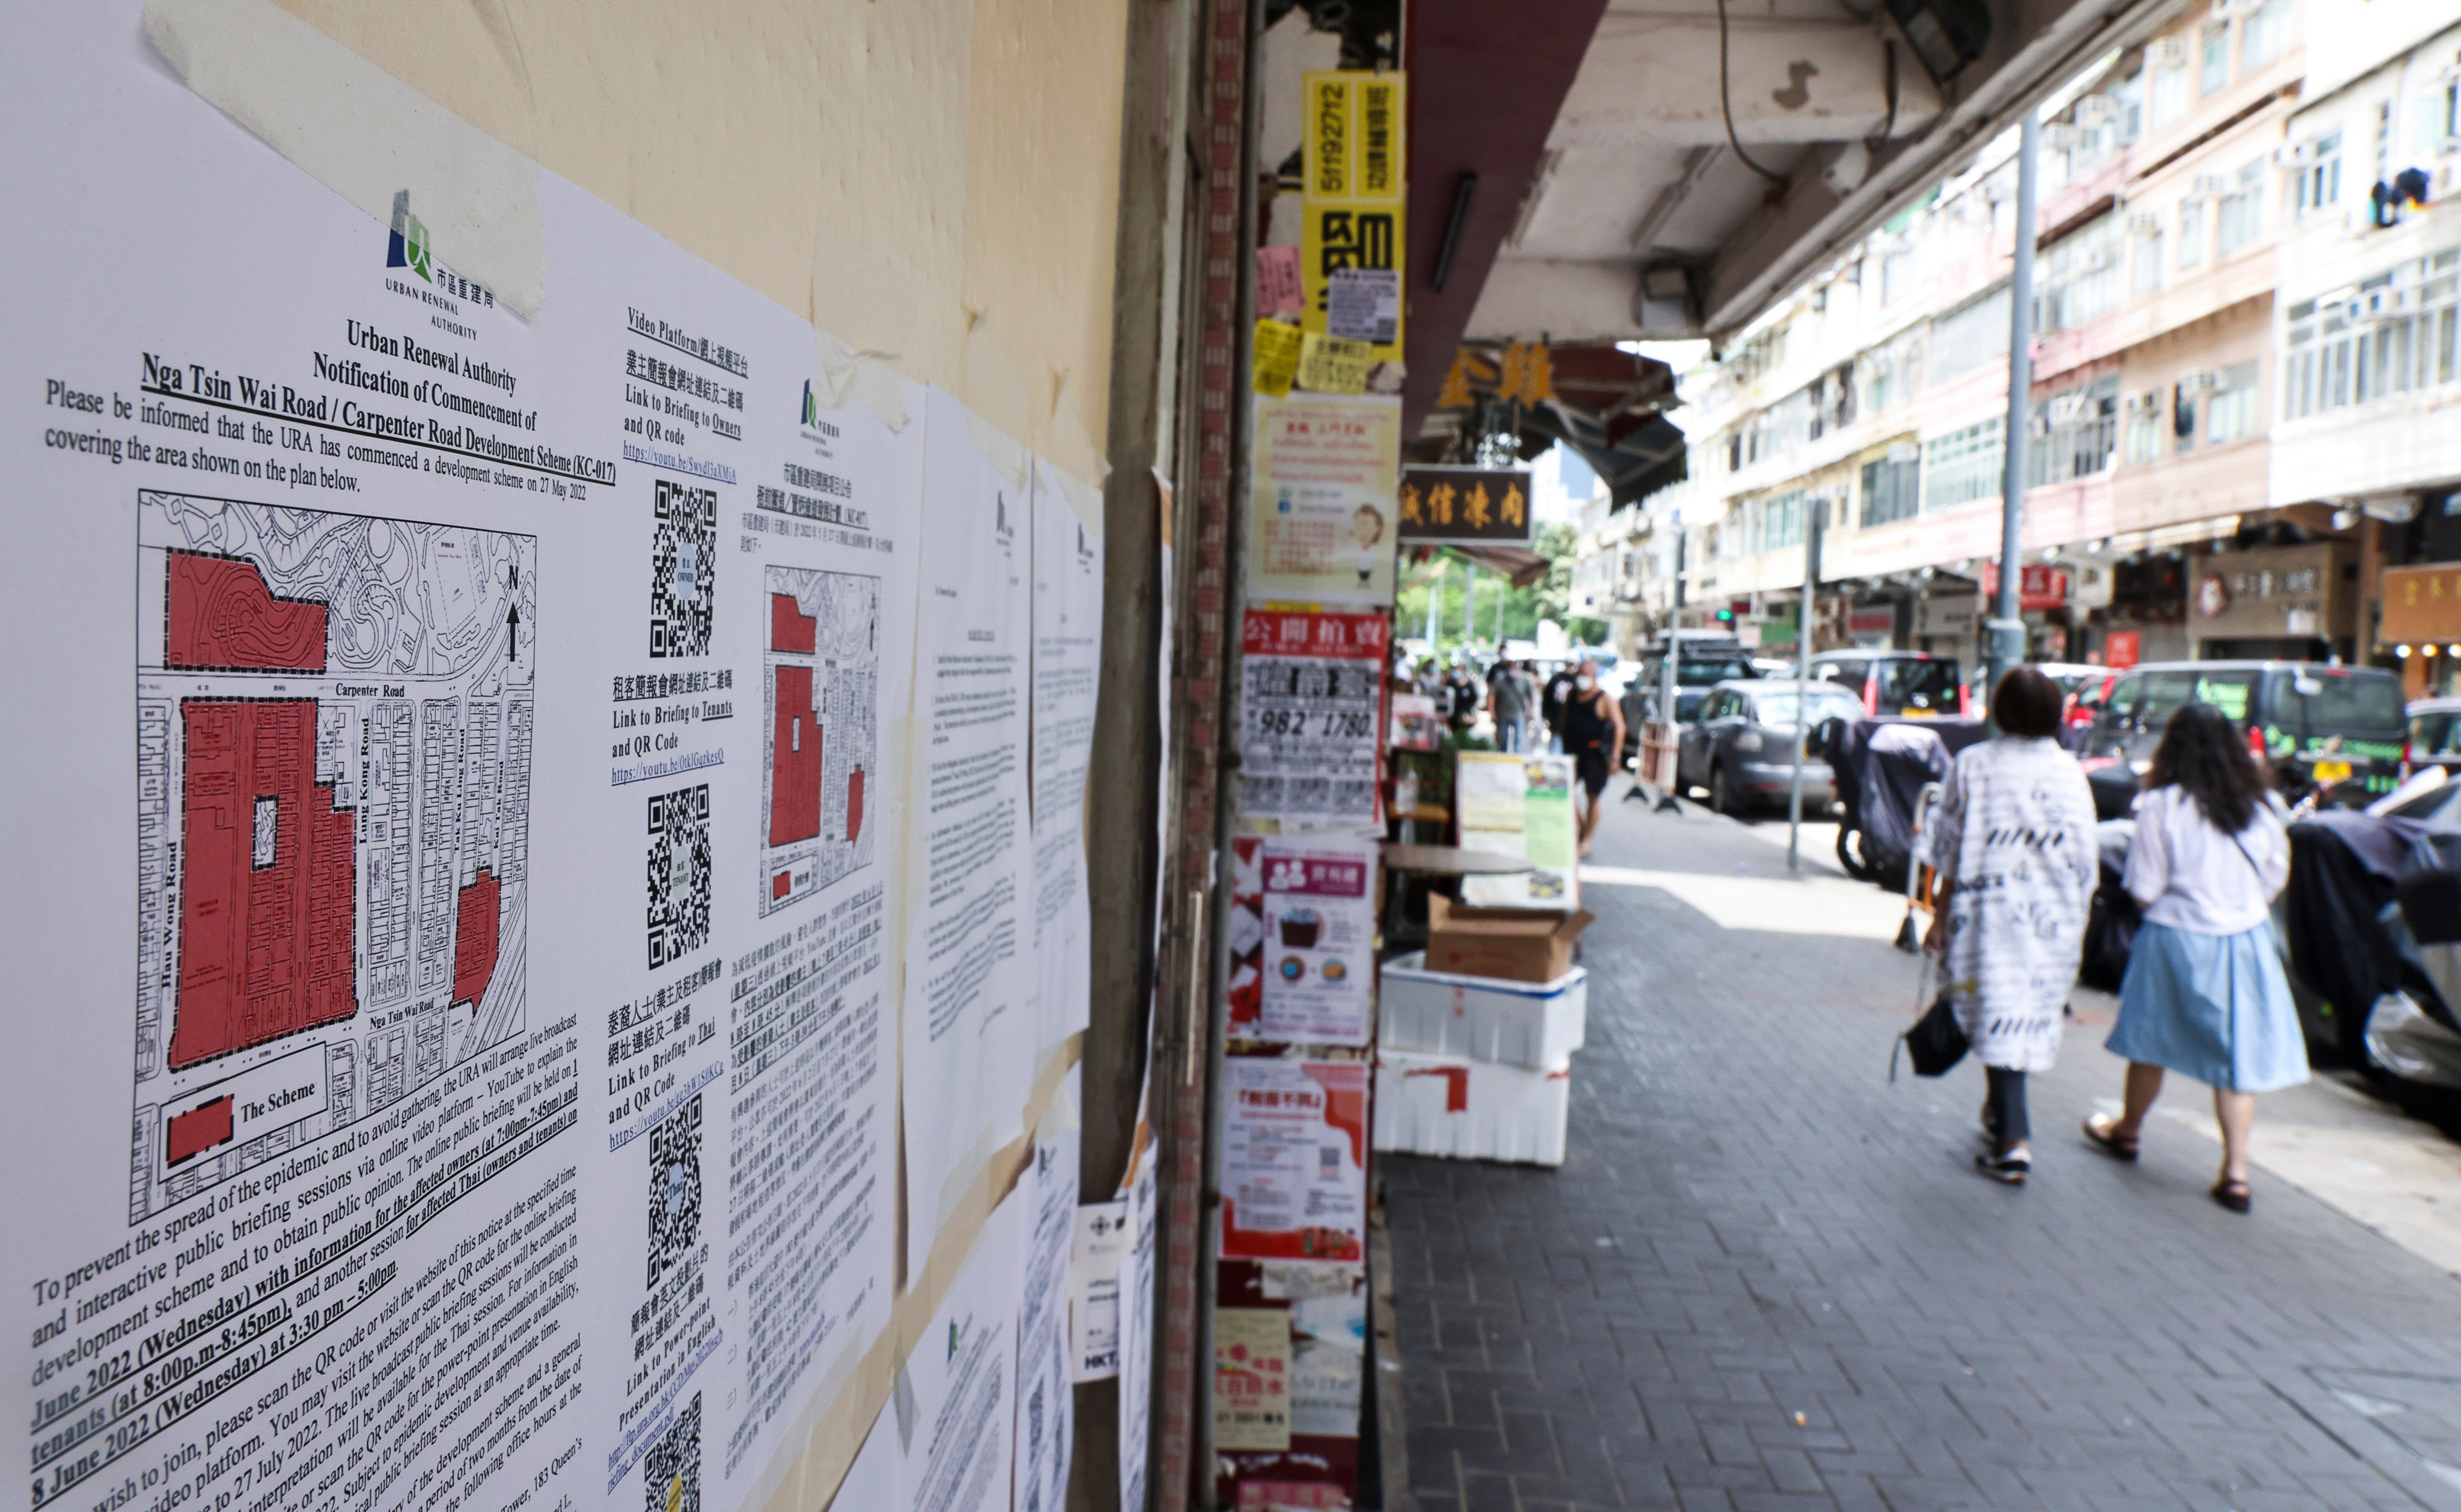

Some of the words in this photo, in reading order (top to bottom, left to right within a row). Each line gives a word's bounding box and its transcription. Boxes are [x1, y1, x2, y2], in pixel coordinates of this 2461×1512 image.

[386, 278, 418, 299] URBAN
[422, 291, 459, 315] RENEWAL
[438, 268, 493, 308] 市區重建局
[432, 315, 477, 340] AUTHORITY
[628, 306, 655, 335] Video
[347, 319, 398, 357] Urban
[403, 335, 459, 375] Renewal
[462, 356, 516, 398] Authority
[314, 351, 409, 399] Notification
[413, 380, 428, 403] of
[432, 383, 522, 428] Commencement
[525, 411, 537, 431] of
[626, 383, 648, 407] Link
[653, 394, 660, 410] to
[665, 396, 699, 428] Briefing
[703, 410, 709, 427] to
[713, 413, 741, 436] Owners
[142, 352, 182, 391] Nga
[190, 364, 231, 401] Tsin
[238, 376, 276, 410] Wai
[282, 386, 328, 425] Road
[342, 401, 424, 440] Carpenter
[427, 418, 463, 453] Road
[465, 427, 536, 469] Development
[536, 445, 573, 476] Scheme
[573, 455, 615, 486] (KC-017)
[625, 417, 642, 434] and
[647, 419, 661, 441] QR
[665, 428, 685, 445] code
[46, 378, 103, 415] Please
[114, 392, 132, 420] be
[141, 397, 209, 434] informed
[217, 414, 245, 441] that
[252, 421, 273, 446] the
[281, 426, 313, 453] URA
[320, 433, 340, 457] has
[347, 445, 418, 470] commenced
[424, 458, 430, 472] a
[435, 455, 490, 484] development
[494, 468, 523, 489] scheme
[528, 478, 537, 492] on
[540, 476, 549, 493] 27
[552, 478, 567, 502] May
[570, 483, 585, 501] 2022
[45, 428, 123, 465] covering
[127, 435, 151, 462] the
[156, 446, 188, 468] area
[192, 447, 239, 475] shown
[244, 461, 261, 478] on
[266, 459, 286, 482] the
[290, 463, 317, 489] plan
[320, 466, 360, 493] below.
[510, 565, 518, 590] N
[678, 572, 693, 582] OWNER
[337, 683, 378, 697] Carpenter
[383, 685, 404, 697] Road
[614, 709, 636, 728] Link
[641, 710, 650, 725] to
[655, 705, 689, 724] Briefing
[692, 704, 698, 718] to
[703, 700, 732, 717] Tenants
[612, 738, 630, 758] and
[635, 736, 650, 757] QR
[656, 732, 678, 751] Code
[360, 761, 370, 800] Kong
[359, 805, 369, 844] Lung
[456, 803, 462, 822] Ku
[166, 842, 177, 887] Road
[673, 873, 689, 886] TENANT
[163, 893, 176, 946] Wong
[162, 951, 172, 988] Hau
[370, 1016, 385, 1029] Nga
[388, 1010, 403, 1024] Tsin
[404, 1004, 418, 1017] Wai
[419, 998, 434, 1013] Road
[609, 1068, 635, 1096] Link
[640, 1064, 649, 1081] to
[653, 1043, 686, 1073] Briefing
[689, 1034, 695, 1047] to
[699, 1017, 715, 1041] Thai
[241, 1102, 264, 1123] The
[269, 1084, 315, 1111] Scheme
[609, 1097, 630, 1124] and
[635, 1088, 650, 1112] QR
[654, 1073, 675, 1097] Code
[32, 1278, 60, 1307] To
[65, 1240, 131, 1300] prevent
[135, 1229, 160, 1255] the
[165, 1195, 215, 1244] spread
[219, 1184, 236, 1213] of
[238, 1179, 260, 1204] the
[264, 1147, 329, 1194] epidemic
[332, 1131, 355, 1160] and
[358, 1130, 369, 1148] to
[372, 1108, 399, 1141] avoid
[401, 1088, 442, 1129] gathering,
[444, 1078, 457, 1097] the
[459, 1062, 480, 1088] URA
[481, 1051, 498, 1075] will
[500, 1041, 528, 1066] arrange
[530, 1032, 543, 1050] live
[544, 1013, 576, 1041] broadcast
[669, 1175, 682, 1200] Thai
[31, 1385, 82, 1431] June
[86, 1349, 132, 1400] 2022
[138, 1285, 250, 1370] (Wednesday)
[255, 1264, 289, 1297] with
[294, 1220, 373, 1278] information
[374, 1207, 392, 1233] for
[393, 1195, 410, 1219] the
[409, 1163, 446, 1207] affected
[447, 1145, 479, 1180] owners
[482, 1133, 495, 1154] (at
[497, 1091, 563, 1144] 7:00pm-7:45pm)
[563, 1081, 578, 1107] and
[627, 1364, 648, 1397] Link
[653, 1354, 660, 1370] to
[665, 1296, 710, 1358] Power-point
[32, 1477, 44, 1506] 8
[50, 1450, 102, 1496] June
[105, 1413, 151, 1465] 2022
[155, 1344, 267, 1433] (Wednesday)
[270, 1332, 287, 1361] at
[288, 1309, 321, 1350] 3:30
[323, 1299, 346, 1329] pm
[357, 1260, 398, 1305] 5:00pm.
[620, 1362, 675, 1433] Presentation
[678, 1351, 685, 1367] in
[688, 1314, 715, 1355] English
[464, 1453, 504, 1501] following
[506, 1433, 530, 1458] office
[534, 1404, 557, 1433] hours
[560, 1394, 567, 1410] at
[570, 1382, 582, 1400] the
[534, 1474, 549, 1492] 183
